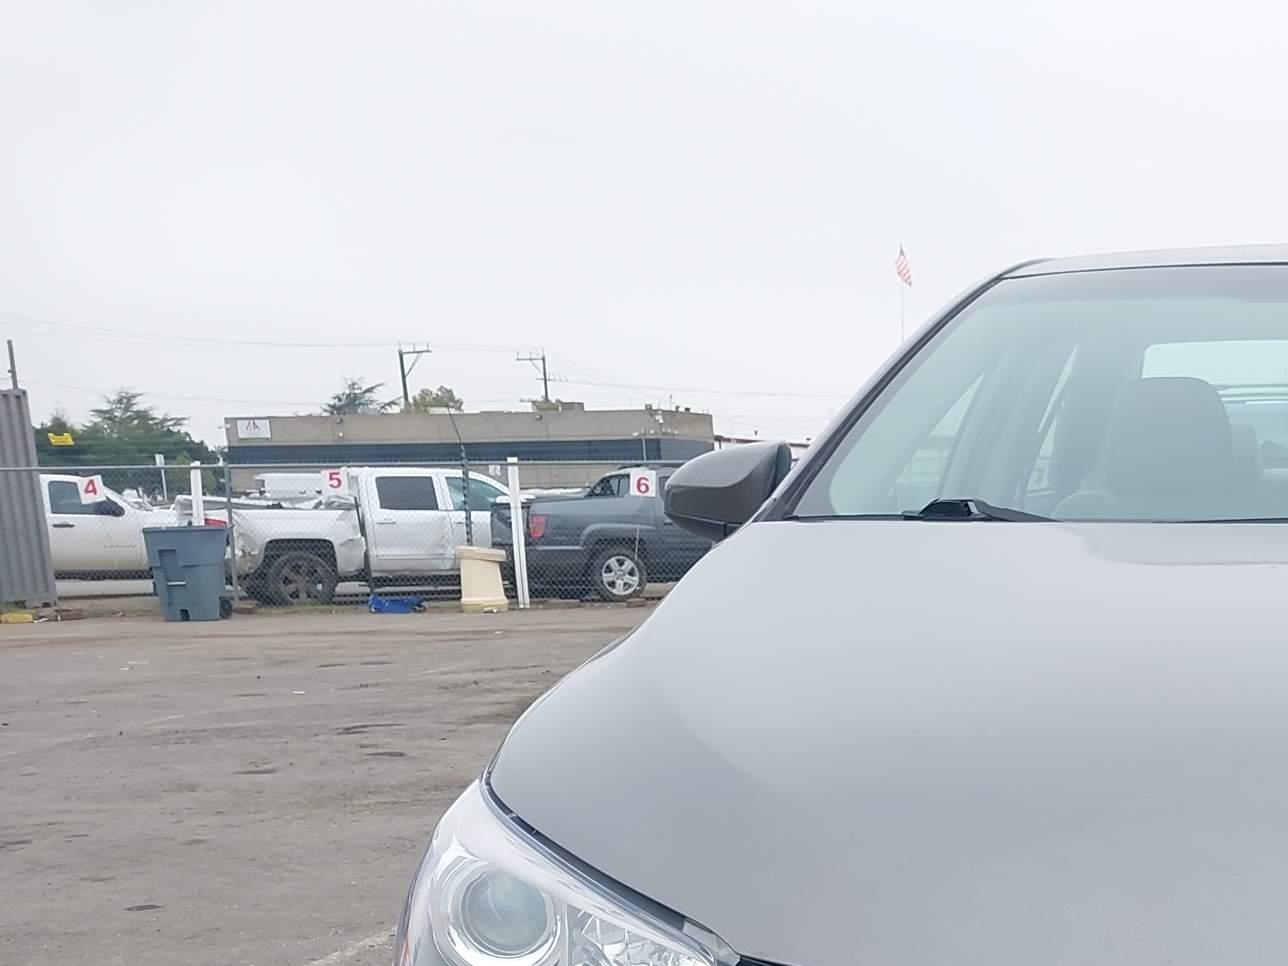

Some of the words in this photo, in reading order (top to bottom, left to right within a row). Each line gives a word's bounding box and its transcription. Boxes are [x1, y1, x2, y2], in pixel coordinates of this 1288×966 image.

[83, 478, 99, 497] 4
[328, 471, 342, 490] 5
[637, 476, 649, 493] 6
